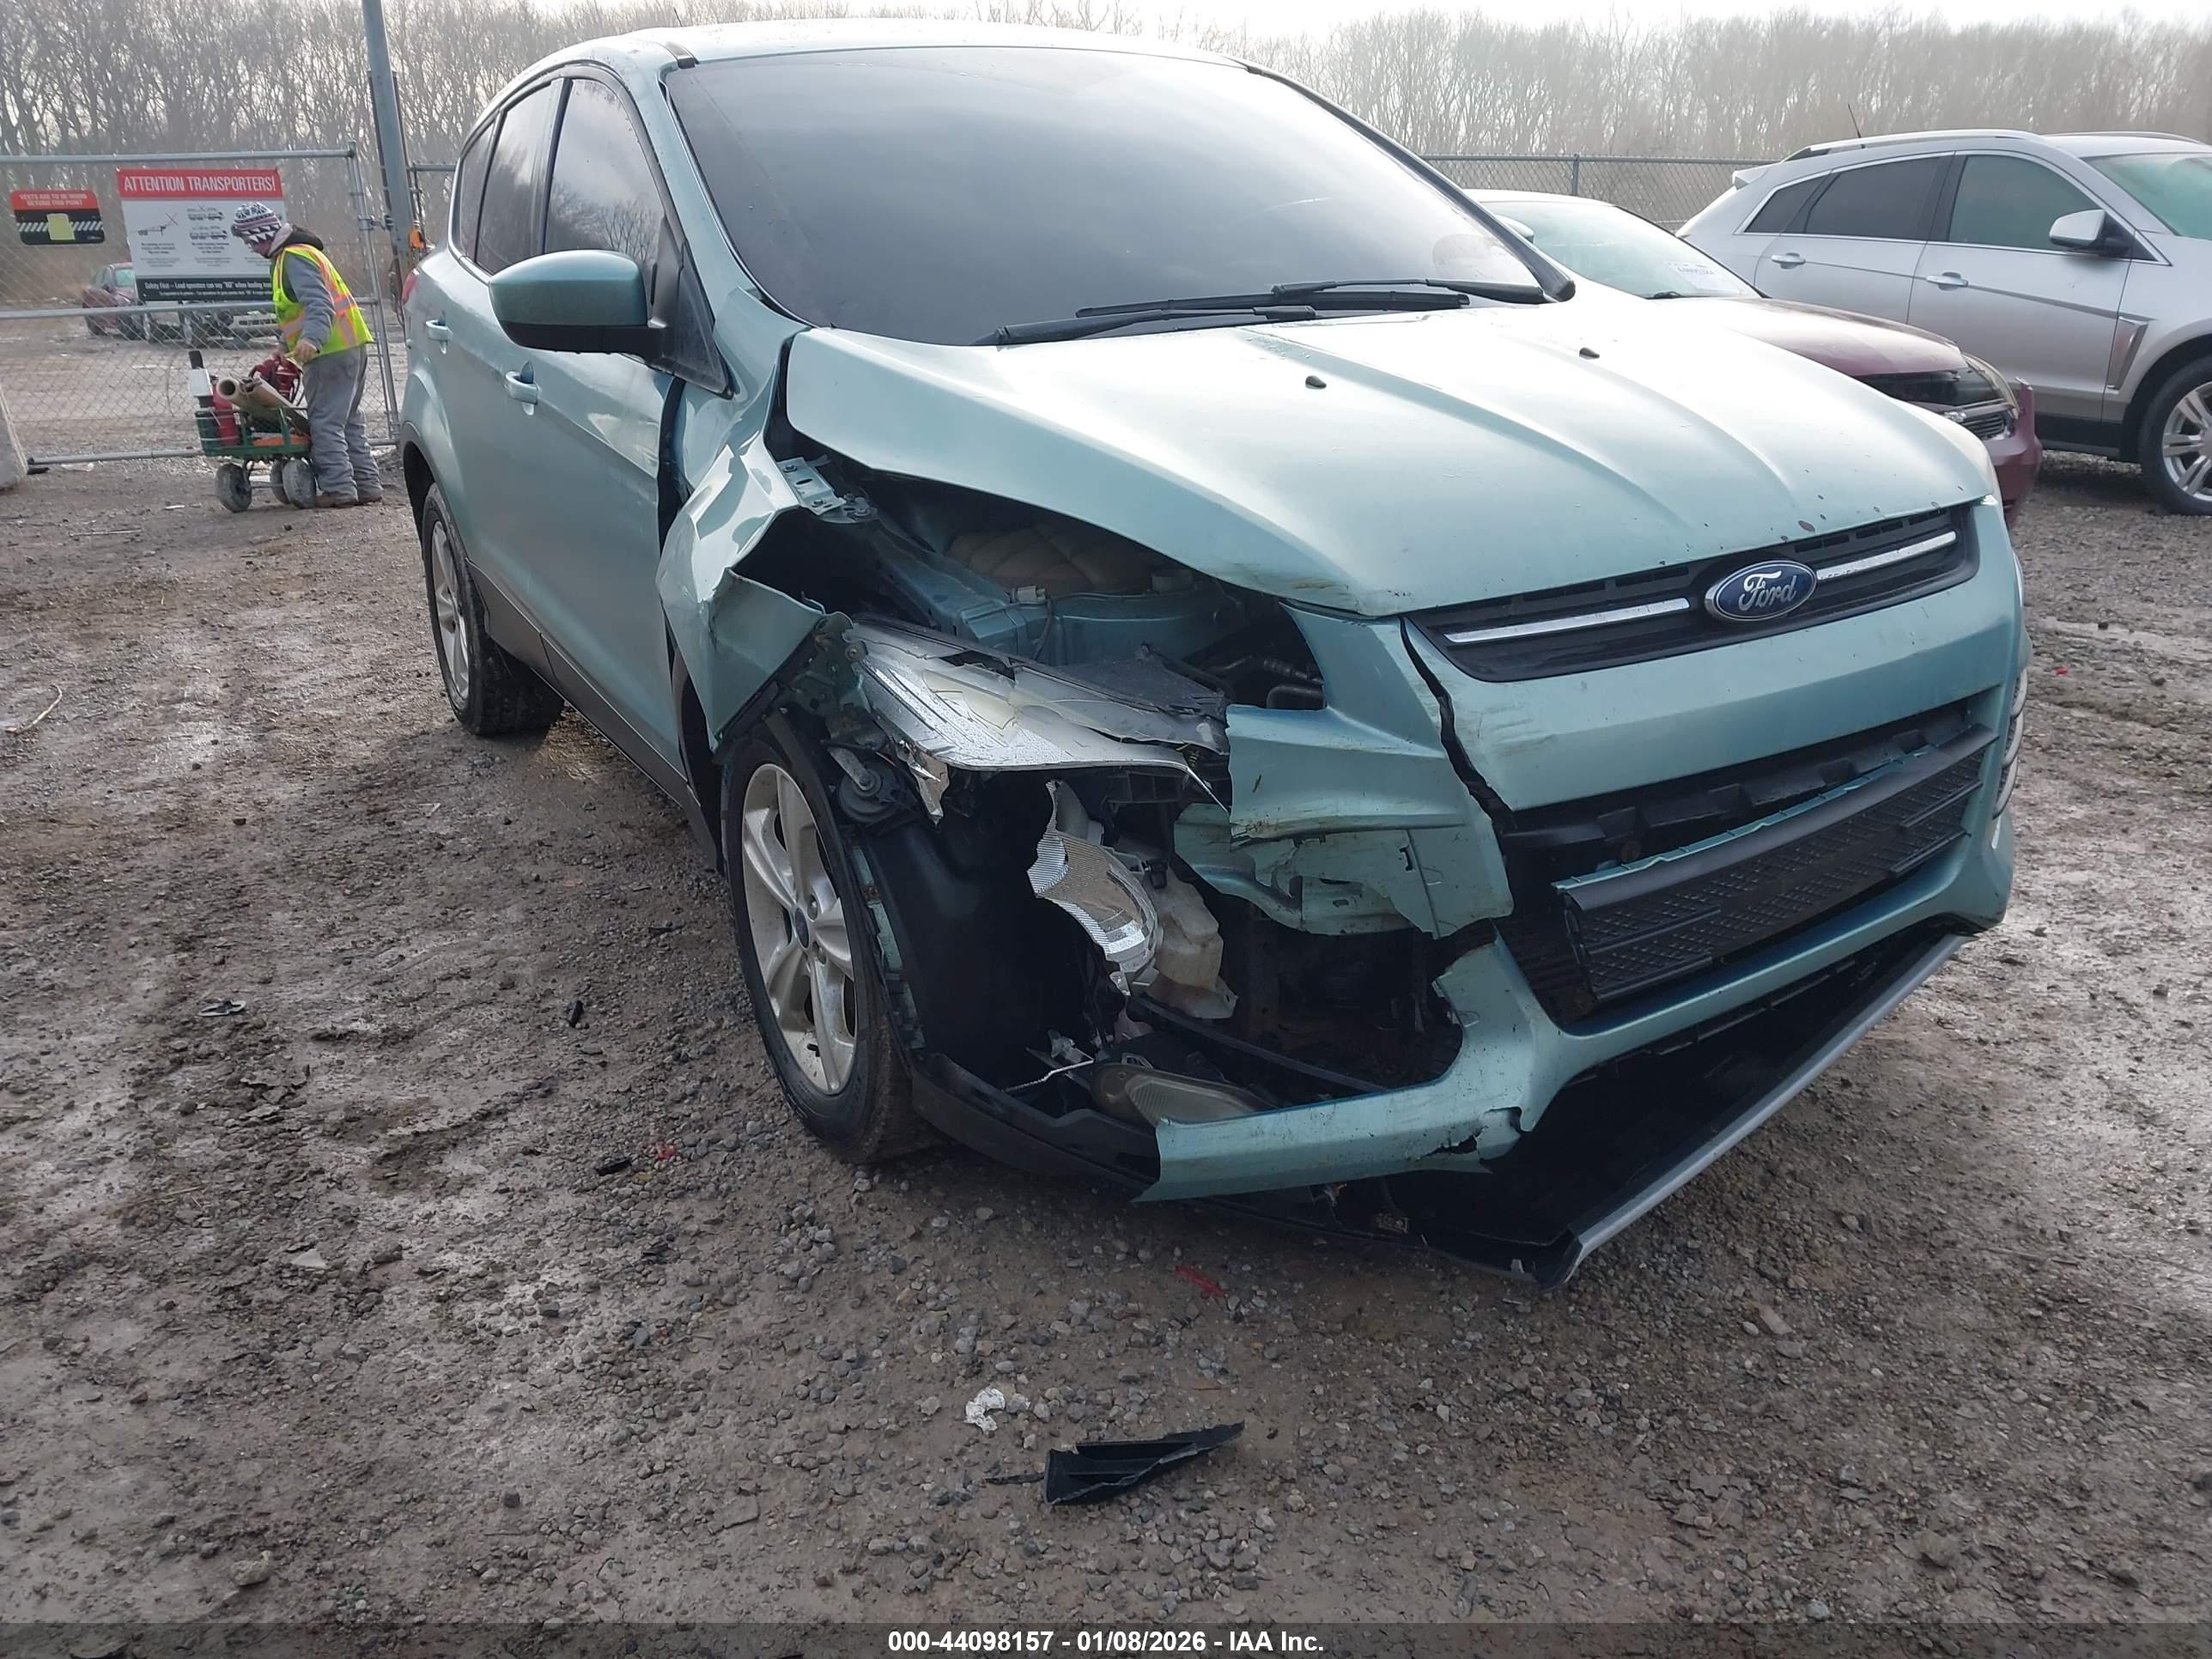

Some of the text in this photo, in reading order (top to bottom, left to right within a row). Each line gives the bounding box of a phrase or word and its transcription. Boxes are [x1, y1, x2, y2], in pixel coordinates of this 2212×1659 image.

[124, 175, 276, 191] ATTENTION TRANSPORTERS!
[1738, 570, 1797, 611] Ford
